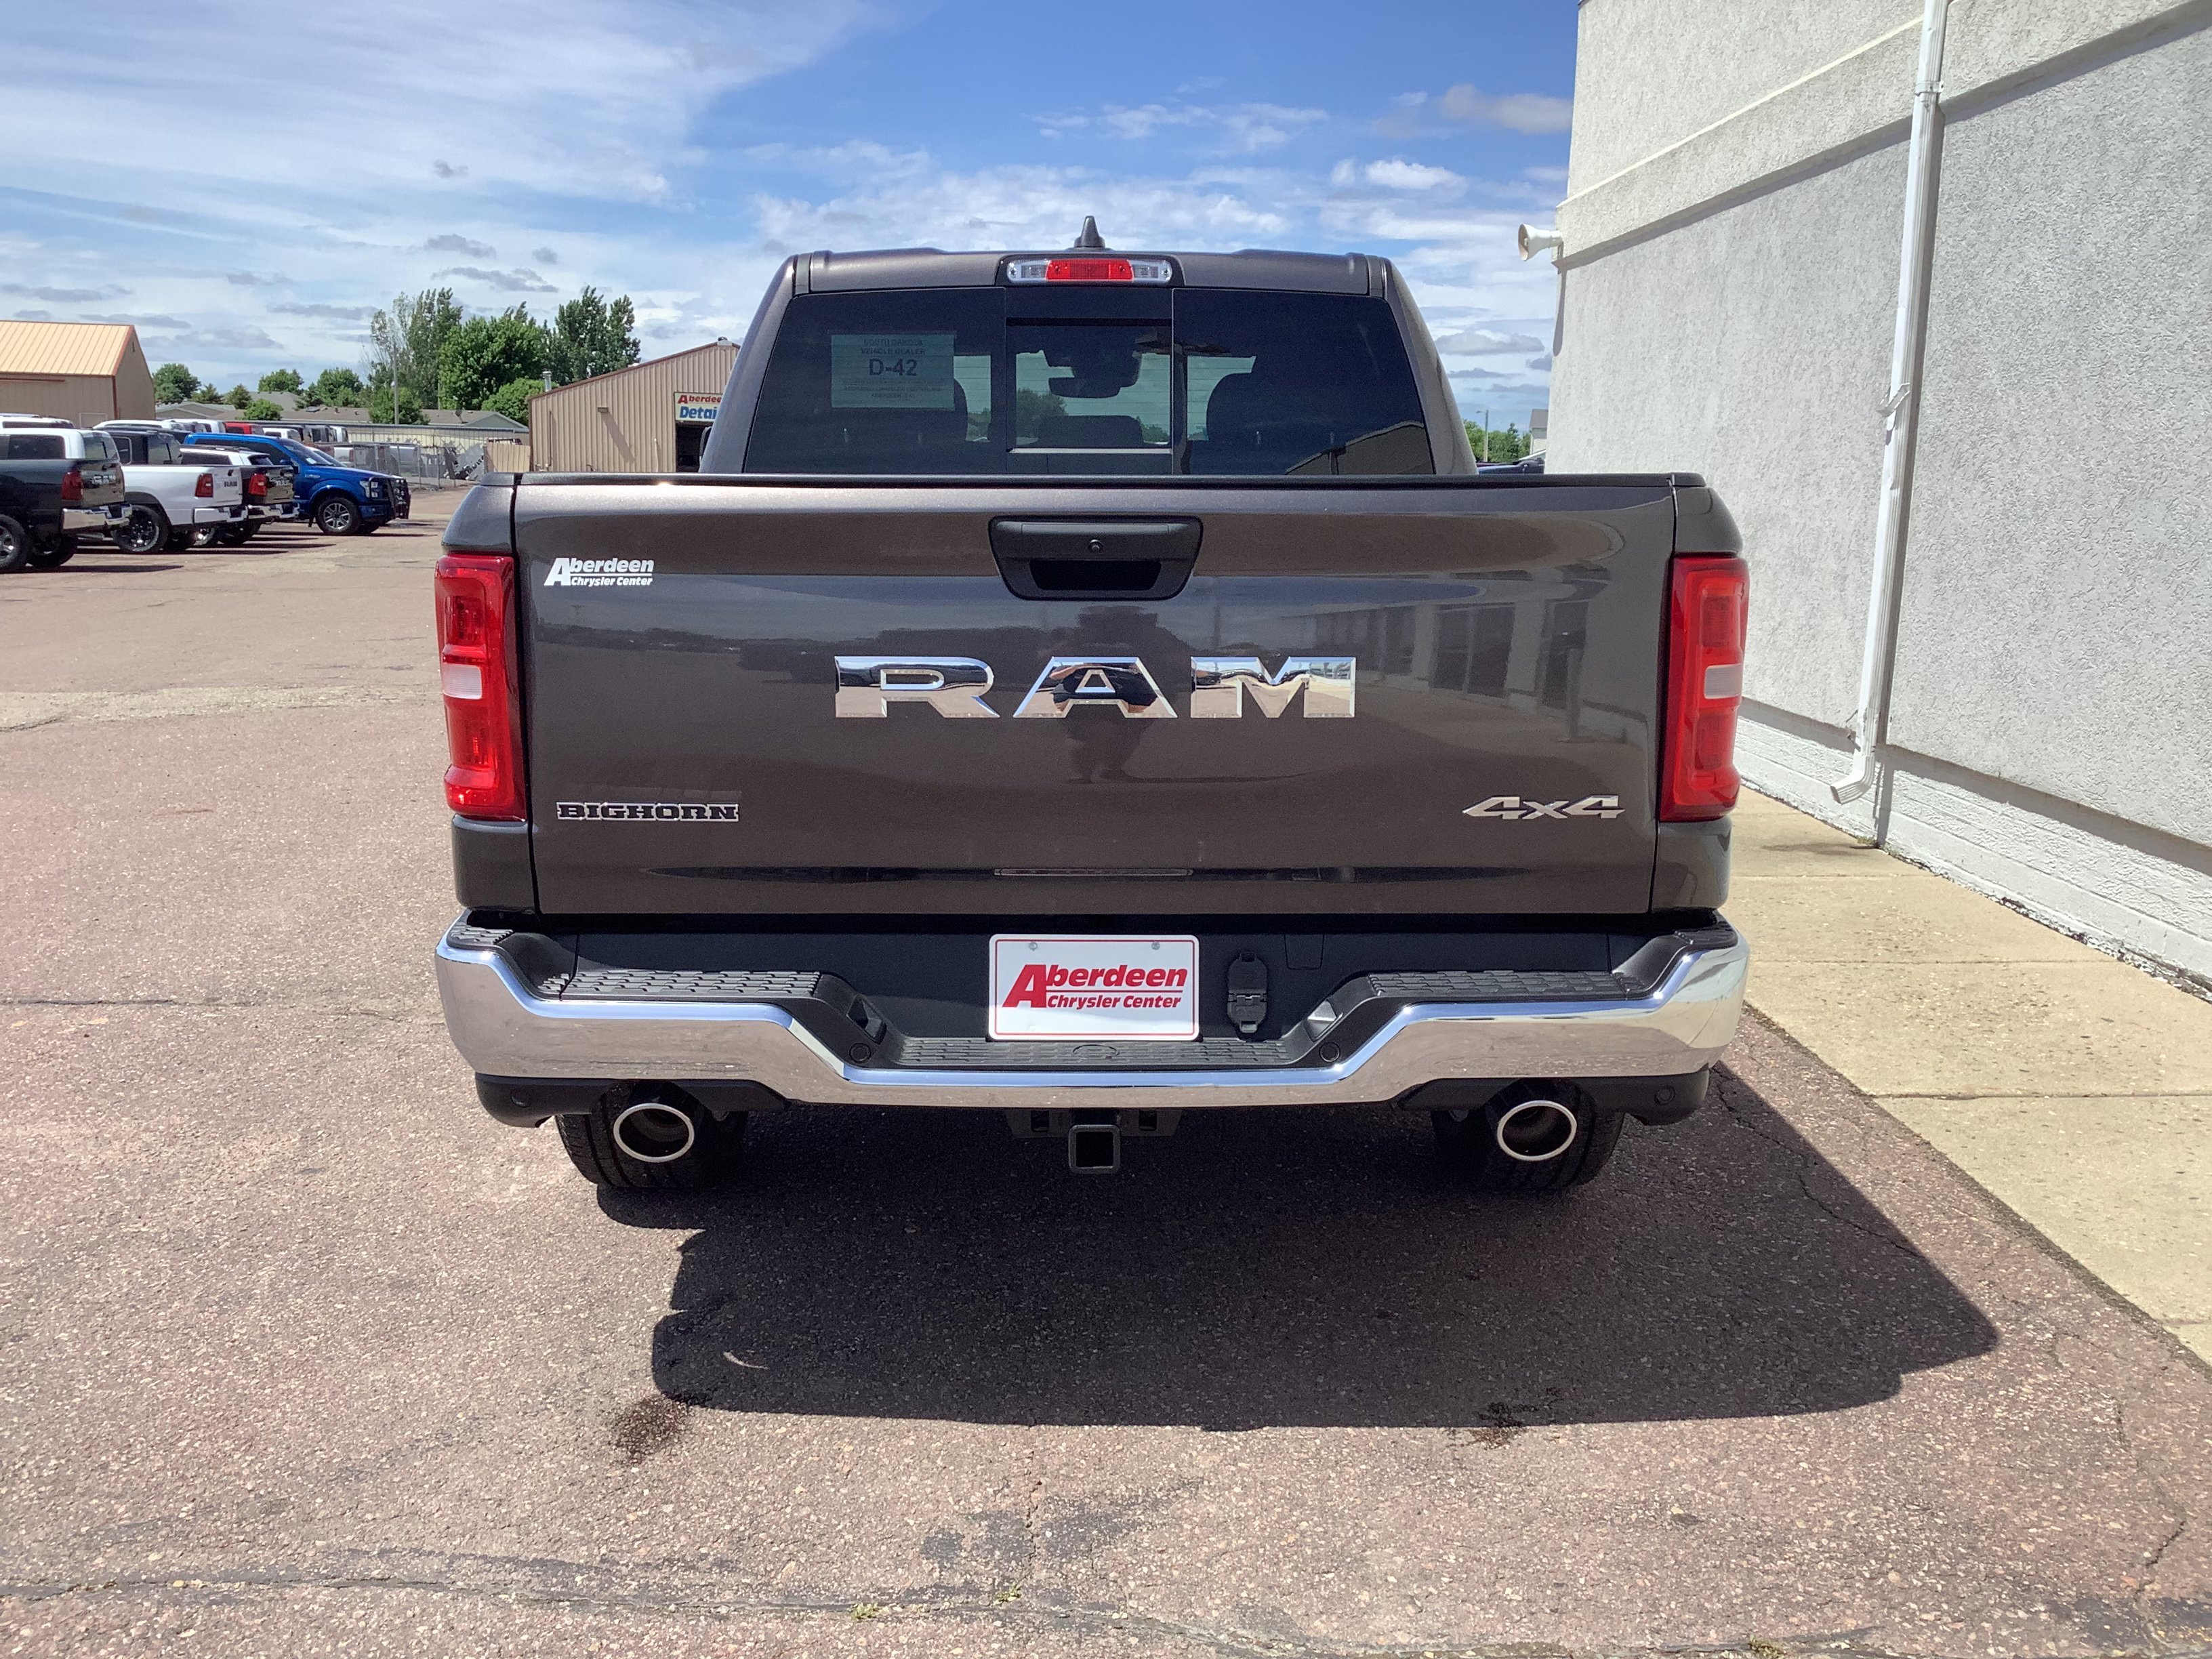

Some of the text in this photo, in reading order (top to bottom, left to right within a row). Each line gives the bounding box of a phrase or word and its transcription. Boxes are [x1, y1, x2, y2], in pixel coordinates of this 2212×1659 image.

[869, 358, 918, 376] D-42
[677, 394, 722, 404] Aberdee
[680, 406, 718, 419] Detai
[544, 558, 655, 586] Aberdeen
[571, 577, 653, 587] Chrysler Center
[835, 656, 1357, 718] RAM
[556, 802, 739, 822] BIGHORN
[1462, 795, 1626, 819] 4x4
[1002, 964, 1188, 1008] Aberdeen
[1047, 995, 1181, 1010] Chrysler Center
